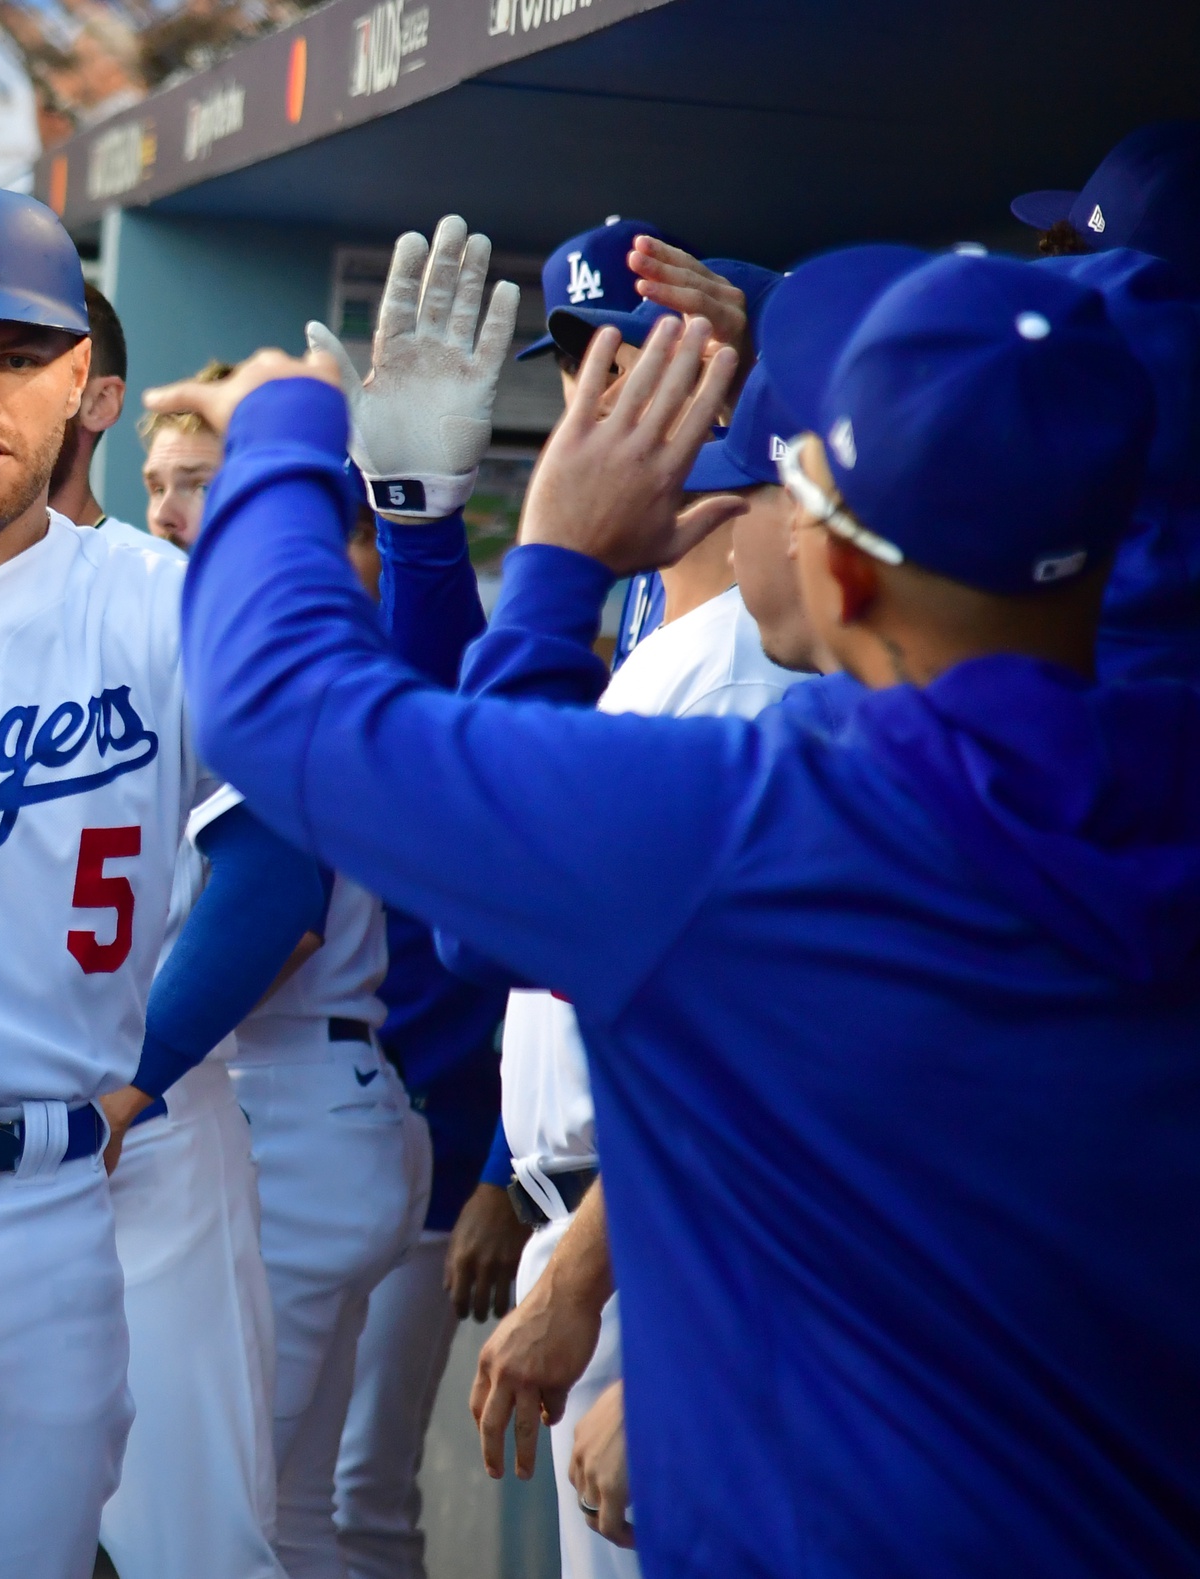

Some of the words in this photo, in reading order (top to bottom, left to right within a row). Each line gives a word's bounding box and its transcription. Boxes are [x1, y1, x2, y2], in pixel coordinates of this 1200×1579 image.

[567, 251, 604, 304] LA
[389, 485, 405, 505] 5
[67, 826, 141, 974] 5
